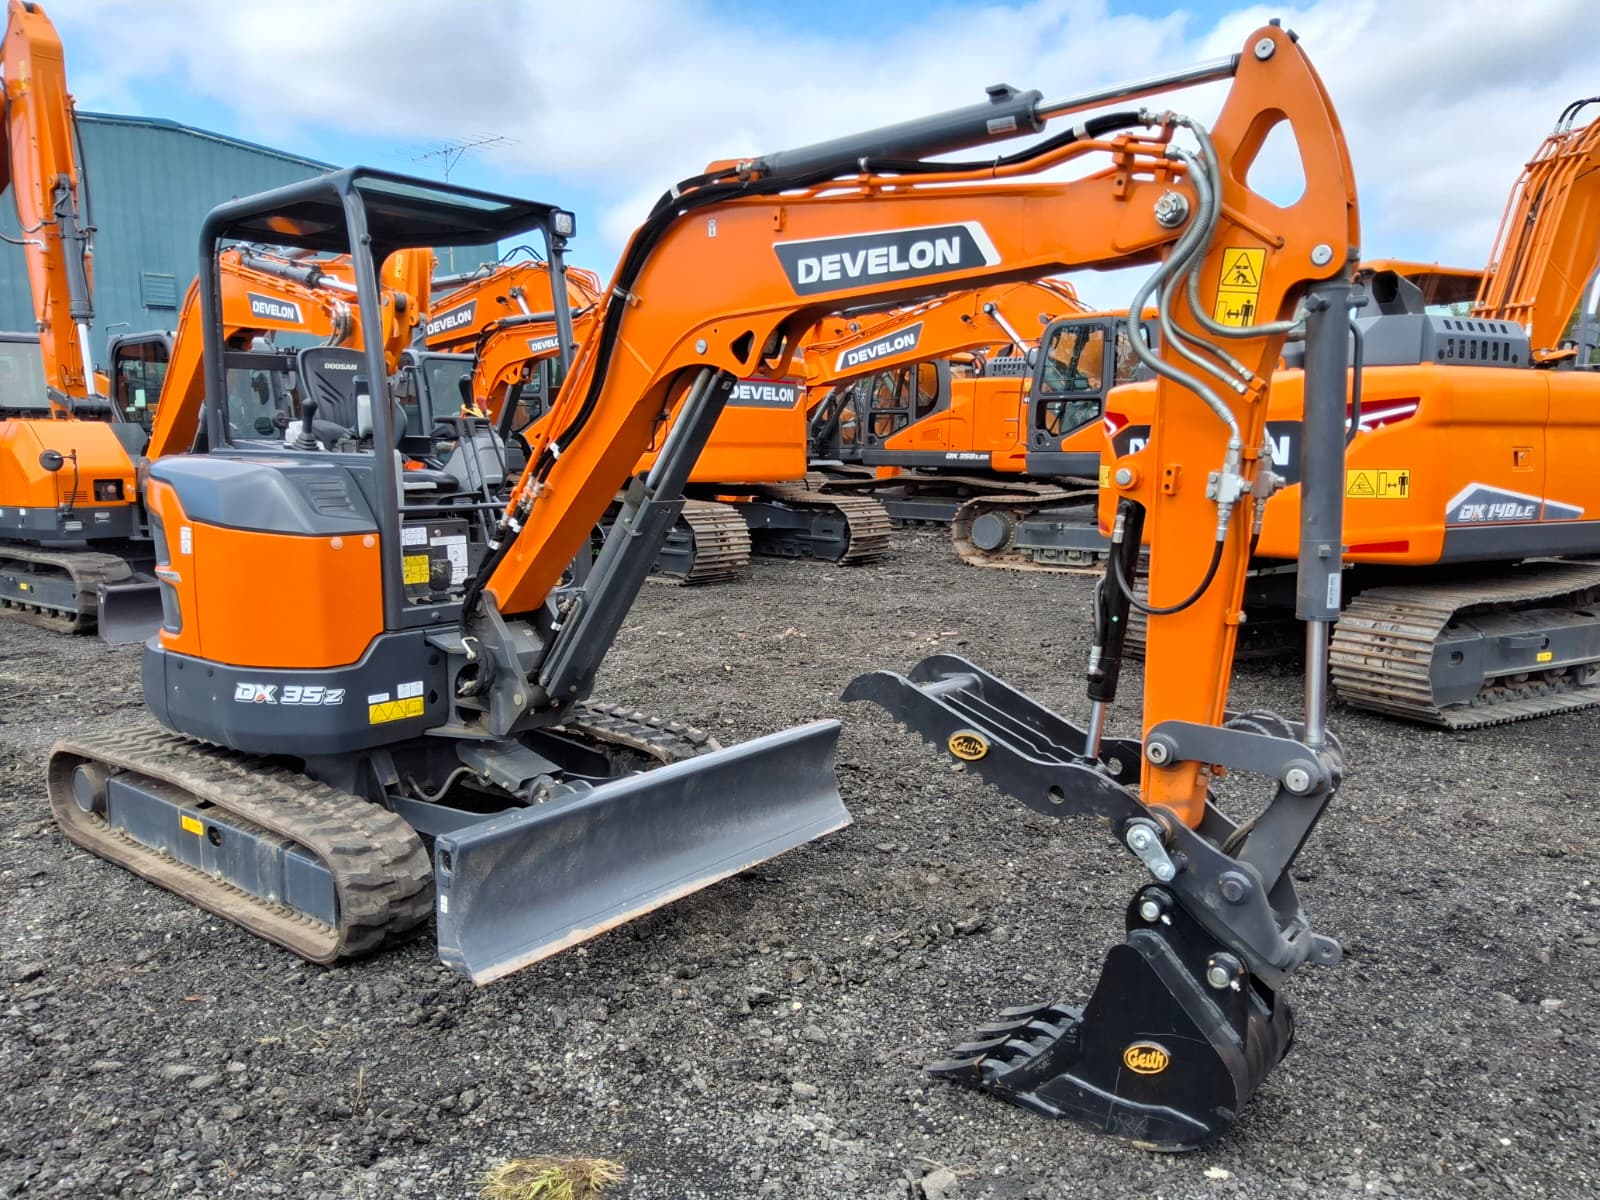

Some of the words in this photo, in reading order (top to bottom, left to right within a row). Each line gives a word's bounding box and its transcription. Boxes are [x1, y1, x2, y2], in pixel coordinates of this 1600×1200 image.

[798, 236, 961, 284] DEVELON
[252, 300, 295, 320] DEVELON
[426, 309, 473, 335] DEVELON
[531, 337, 560, 352] DEVELO
[847, 333, 916, 366] DEVELON
[323, 362, 358, 371] DOOSAN
